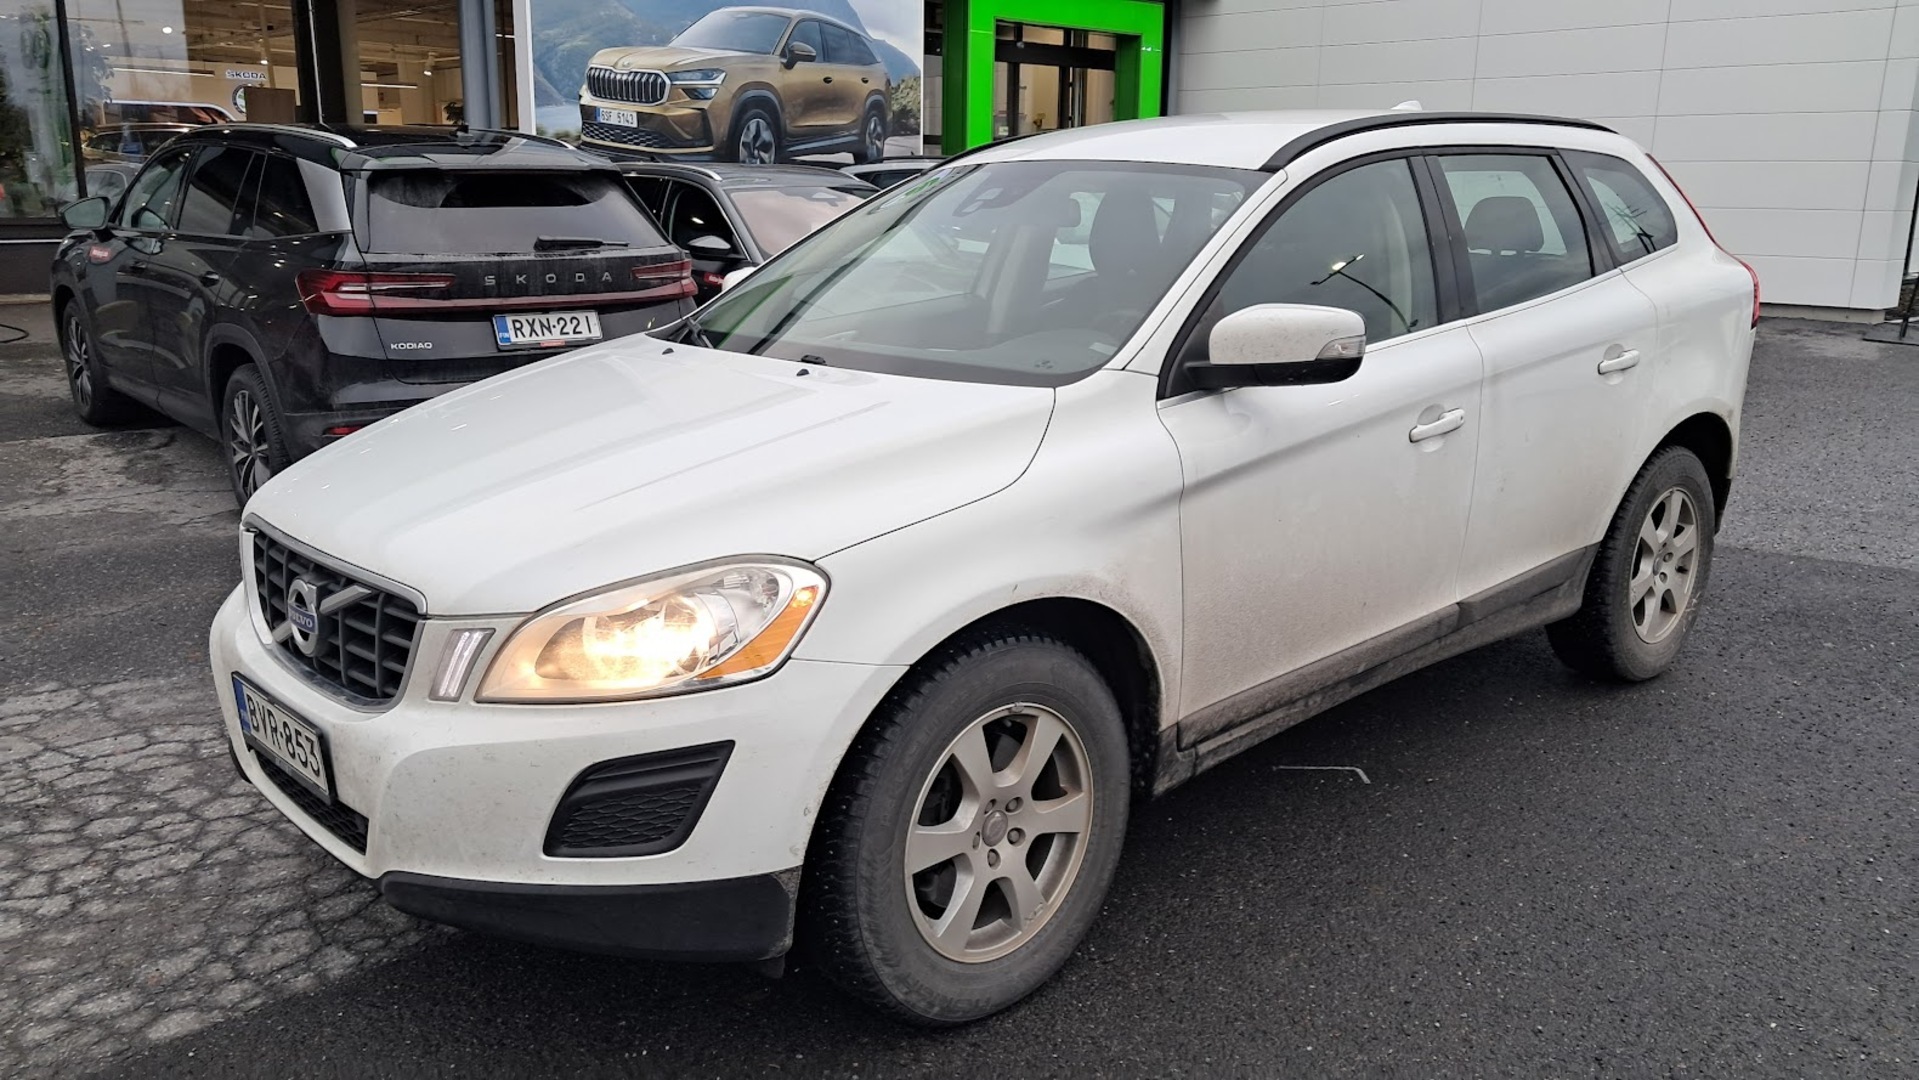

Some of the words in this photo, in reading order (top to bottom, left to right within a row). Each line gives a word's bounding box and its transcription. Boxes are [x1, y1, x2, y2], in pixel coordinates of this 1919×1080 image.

[484, 271, 613, 286] SKODA
[511, 315, 592, 338] RXN-221
[246, 693, 320, 778] BVR-853
